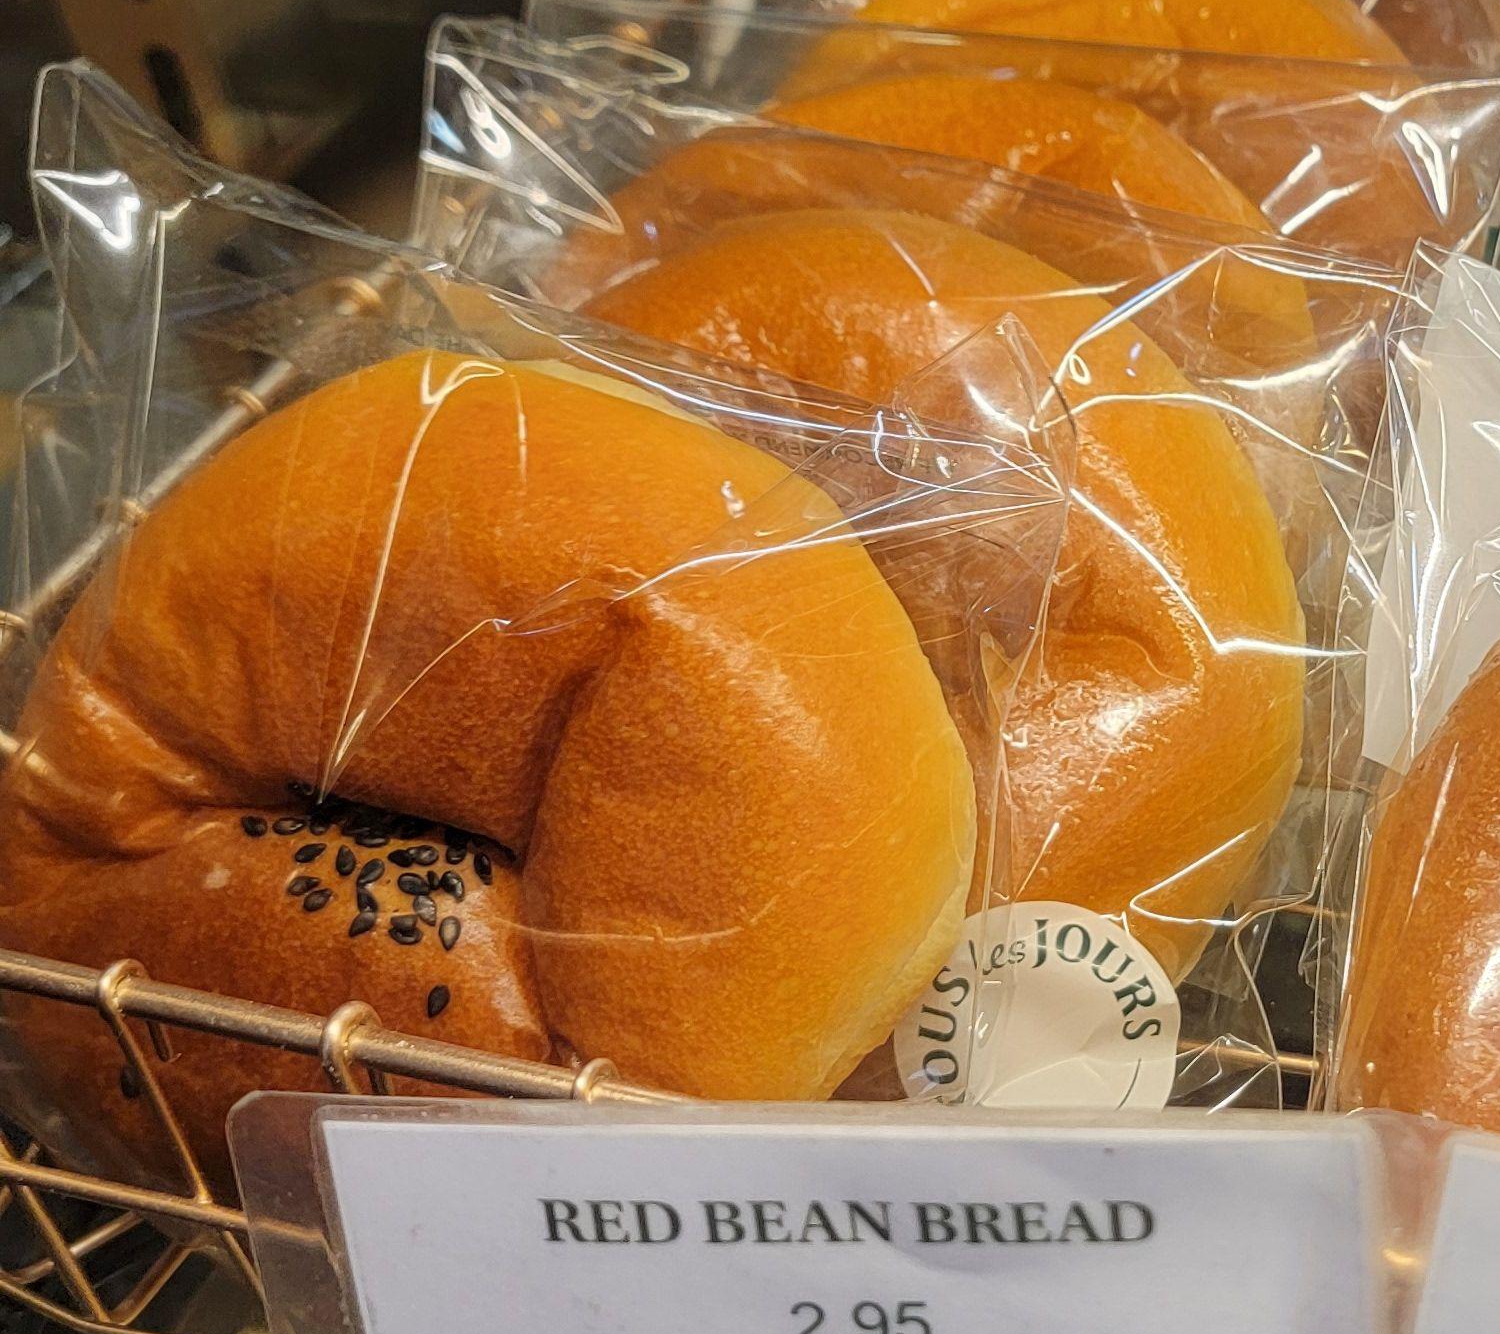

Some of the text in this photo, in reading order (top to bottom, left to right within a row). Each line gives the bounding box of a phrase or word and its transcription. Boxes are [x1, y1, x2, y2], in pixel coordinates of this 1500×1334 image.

[917, 965, 972, 1103] OUS
[1032, 917, 1162, 1042] JOURS
[538, 1197, 1156, 1245] RED BEAN BREAD
